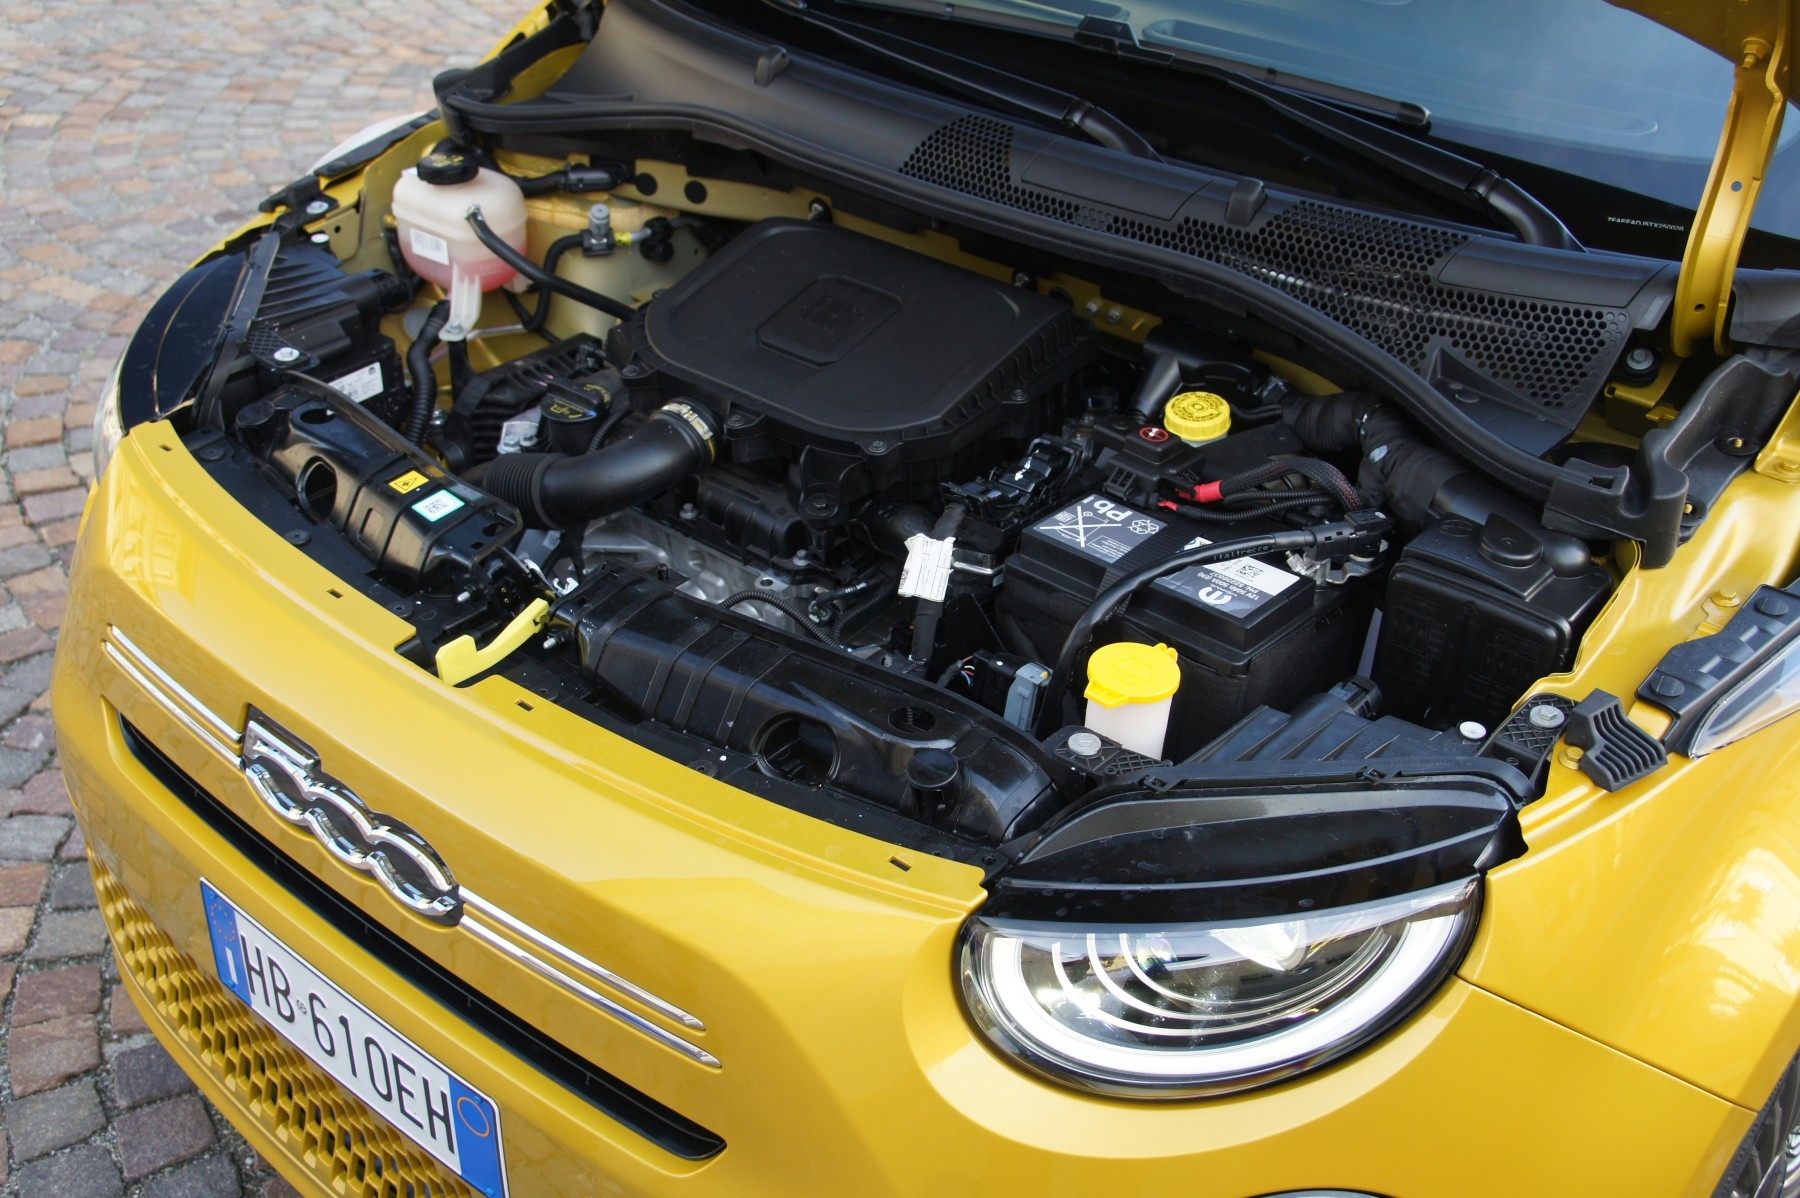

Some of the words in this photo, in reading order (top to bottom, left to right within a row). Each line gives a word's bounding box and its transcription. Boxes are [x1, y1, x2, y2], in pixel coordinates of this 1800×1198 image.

[1093, 500, 1133, 521] Pb
[1213, 545, 1269, 560] italtrecce
[1245, 592, 1260, 601] 12V
[244, 720, 457, 916] 500
[240, 934, 296, 1023] HB
